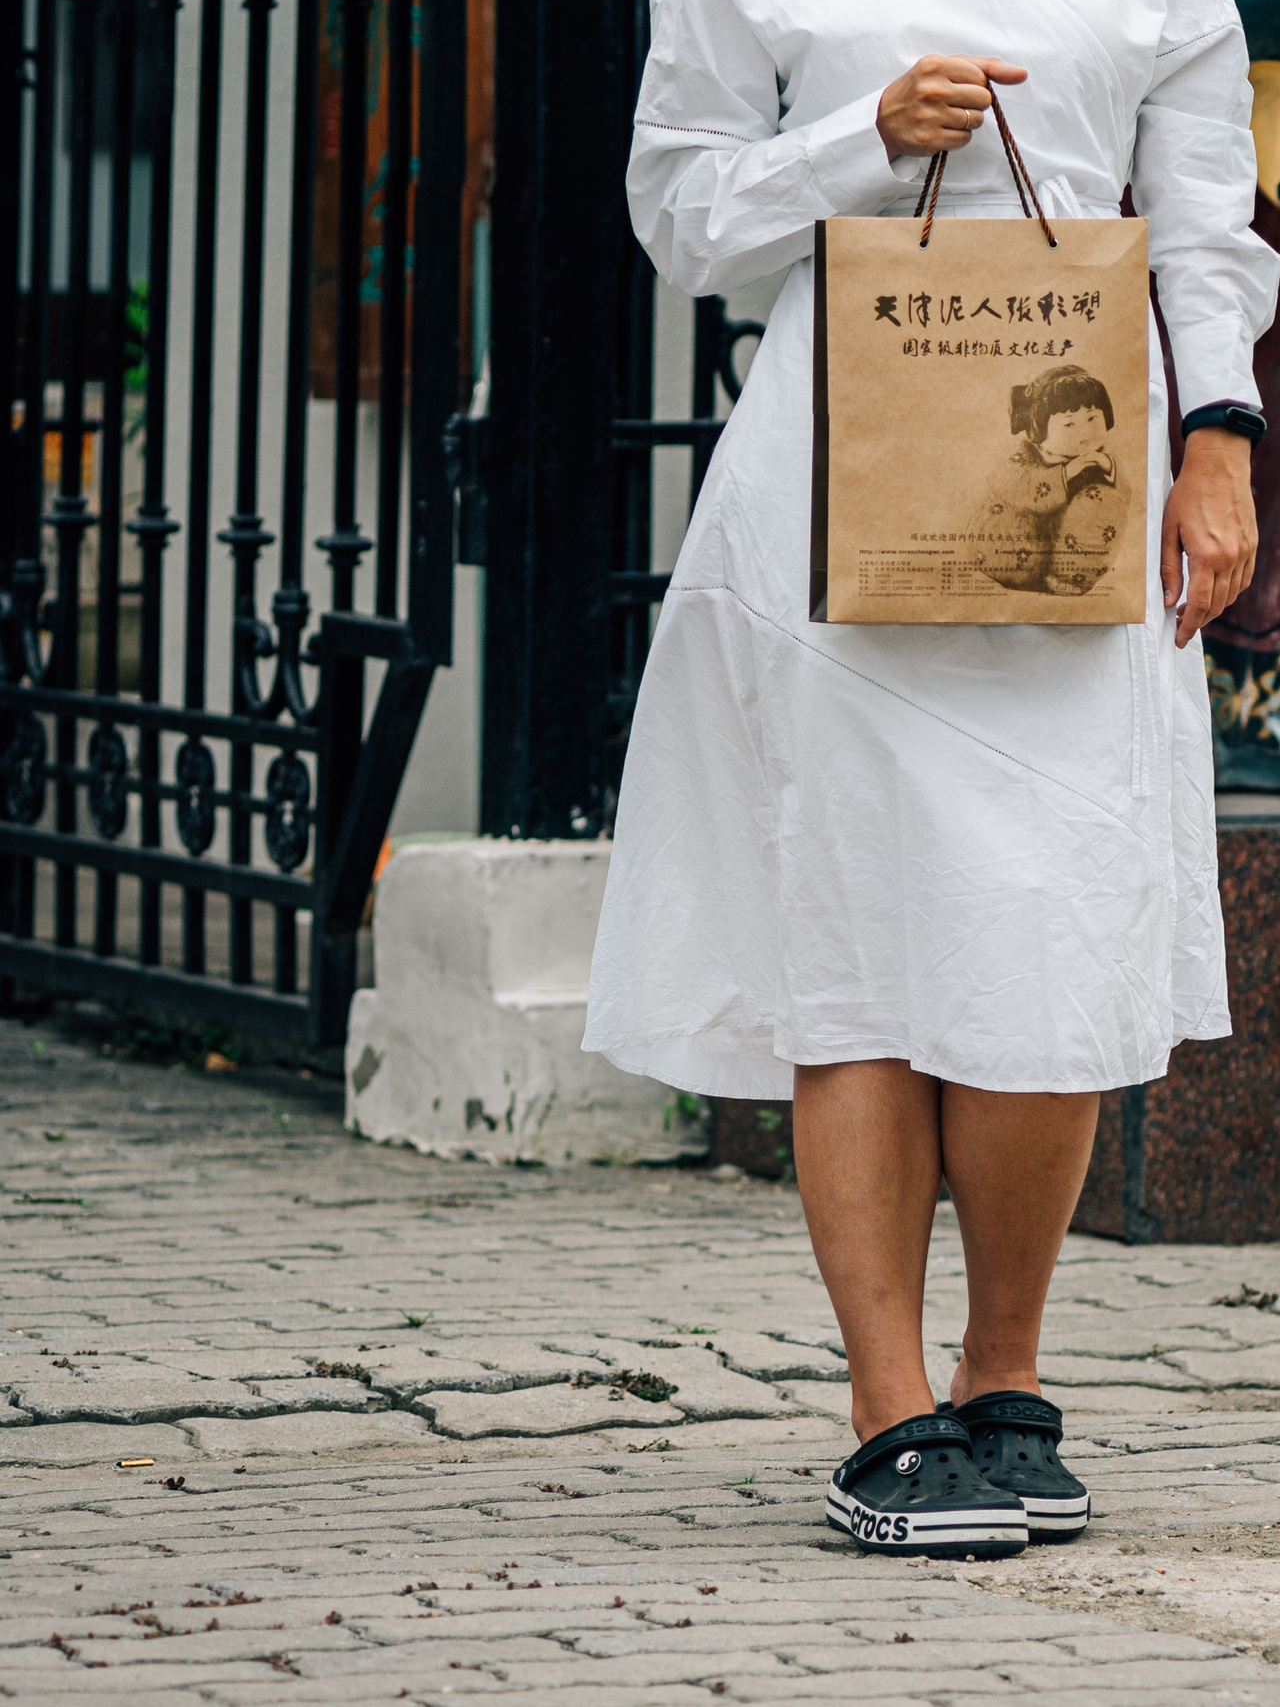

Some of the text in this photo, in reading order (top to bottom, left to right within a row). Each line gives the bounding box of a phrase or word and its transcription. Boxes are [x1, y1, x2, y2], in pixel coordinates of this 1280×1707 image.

[902, 338, 1074, 358] 国家级非物质文化遗产
[851, 1505, 909, 1542] crocs
